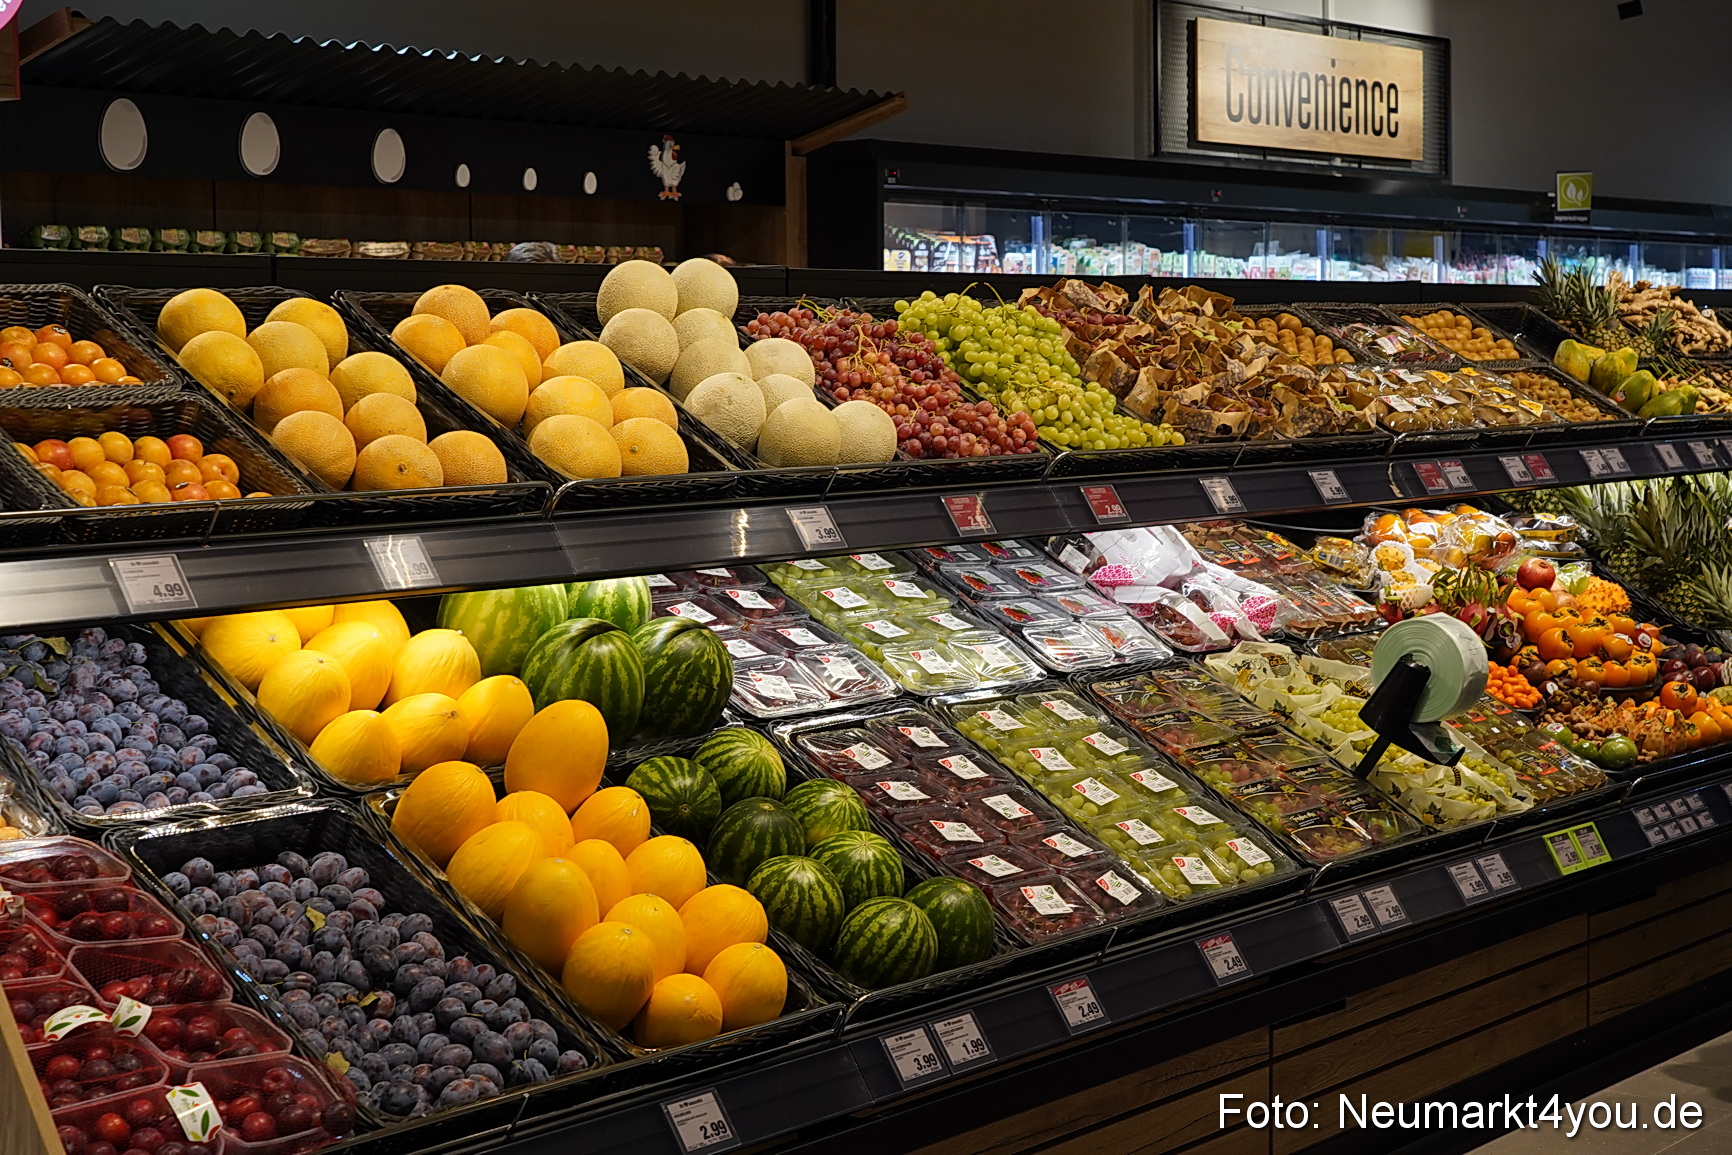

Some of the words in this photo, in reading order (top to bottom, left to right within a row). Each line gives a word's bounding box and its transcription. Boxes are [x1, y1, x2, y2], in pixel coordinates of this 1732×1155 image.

[1225, 44, 1400, 139] Convenience
[1104, 503, 1123, 515] 2.99
[815, 527, 837, 540] 3.99
[153, 582, 184, 598] 4.99
[1385, 905, 1403, 918] 2.99
[1353, 914, 1371, 928] 2.99
[1223, 956, 1243, 971] 2.49
[1078, 1001, 1100, 1018] 2.49
[962, 1037, 985, 1056] 1.99
[913, 1052, 938, 1071] 3.99
[699, 1119, 728, 1140] 2.99
